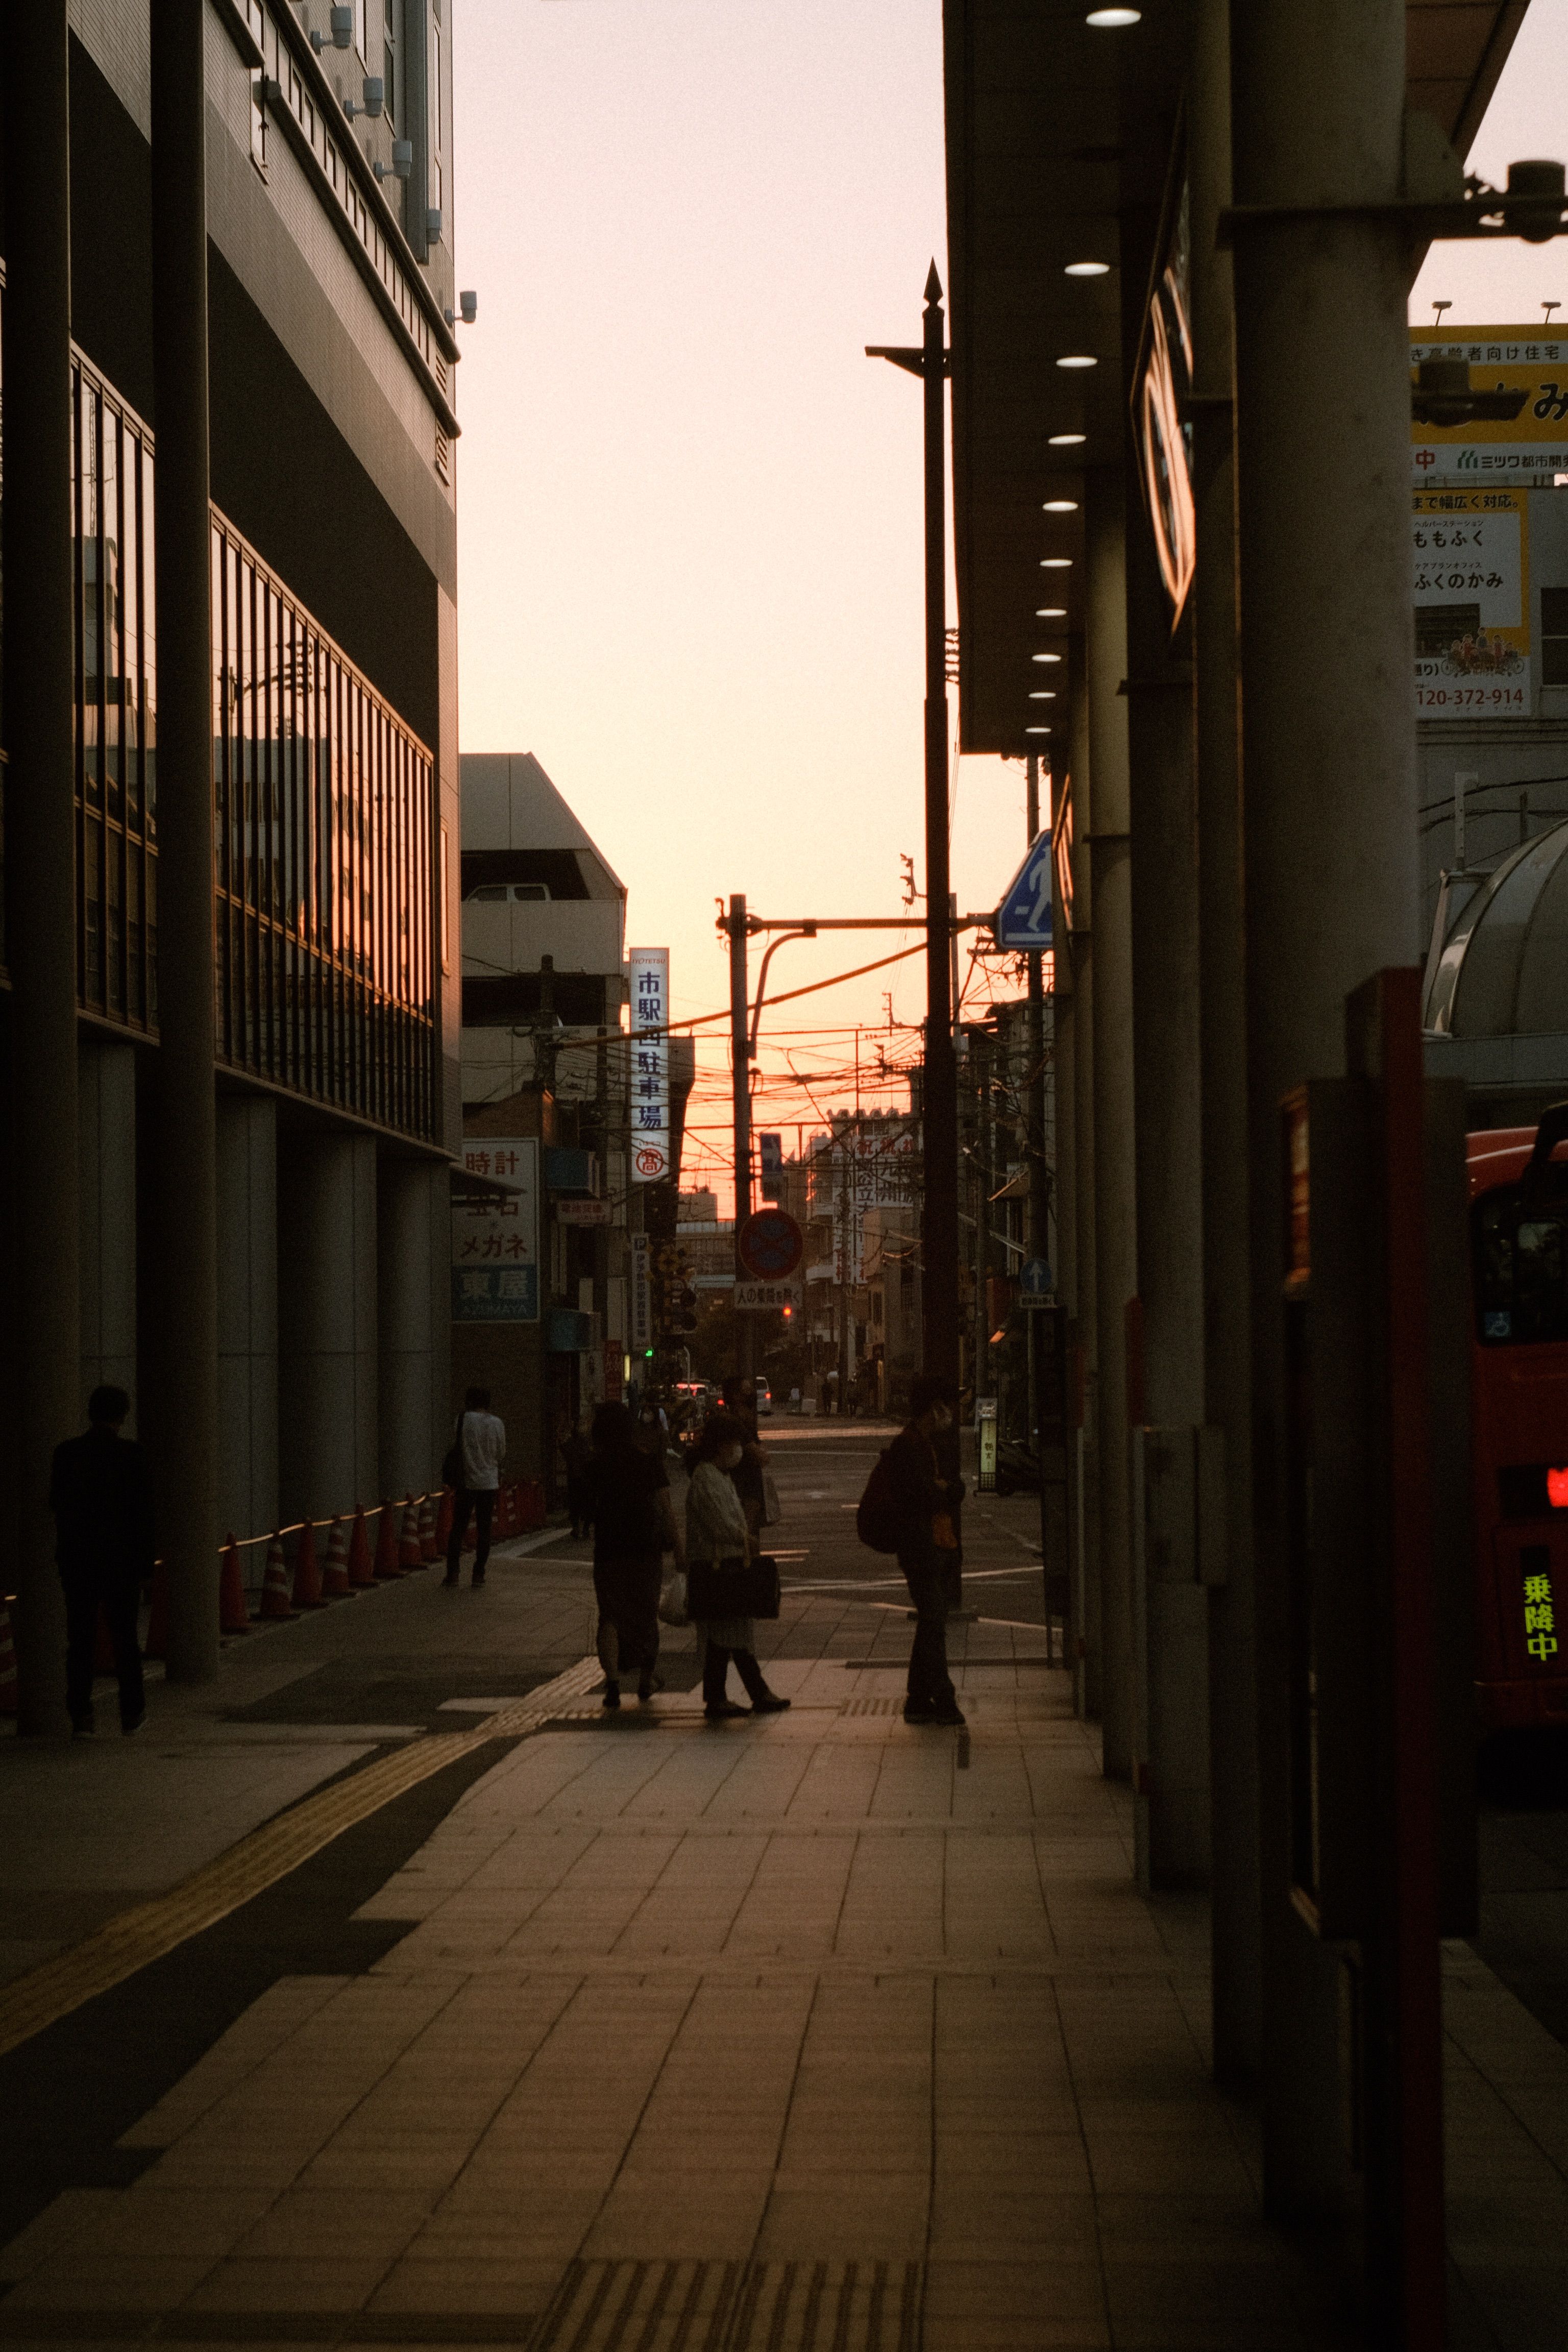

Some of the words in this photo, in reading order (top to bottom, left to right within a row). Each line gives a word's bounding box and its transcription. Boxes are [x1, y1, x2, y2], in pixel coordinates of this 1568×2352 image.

[1413, 530, 1483, 548] ももふく
[1414, 572, 1504, 590] ふくのかみ
[638, 971, 662, 1130] 市駅西駐車場
[465, 1150, 520, 1175] 時計
[460, 1233, 528, 1258] メガネ
[460, 1270, 529, 1301] 東屋
[1523, 1573, 1558, 1661] 乗降中
